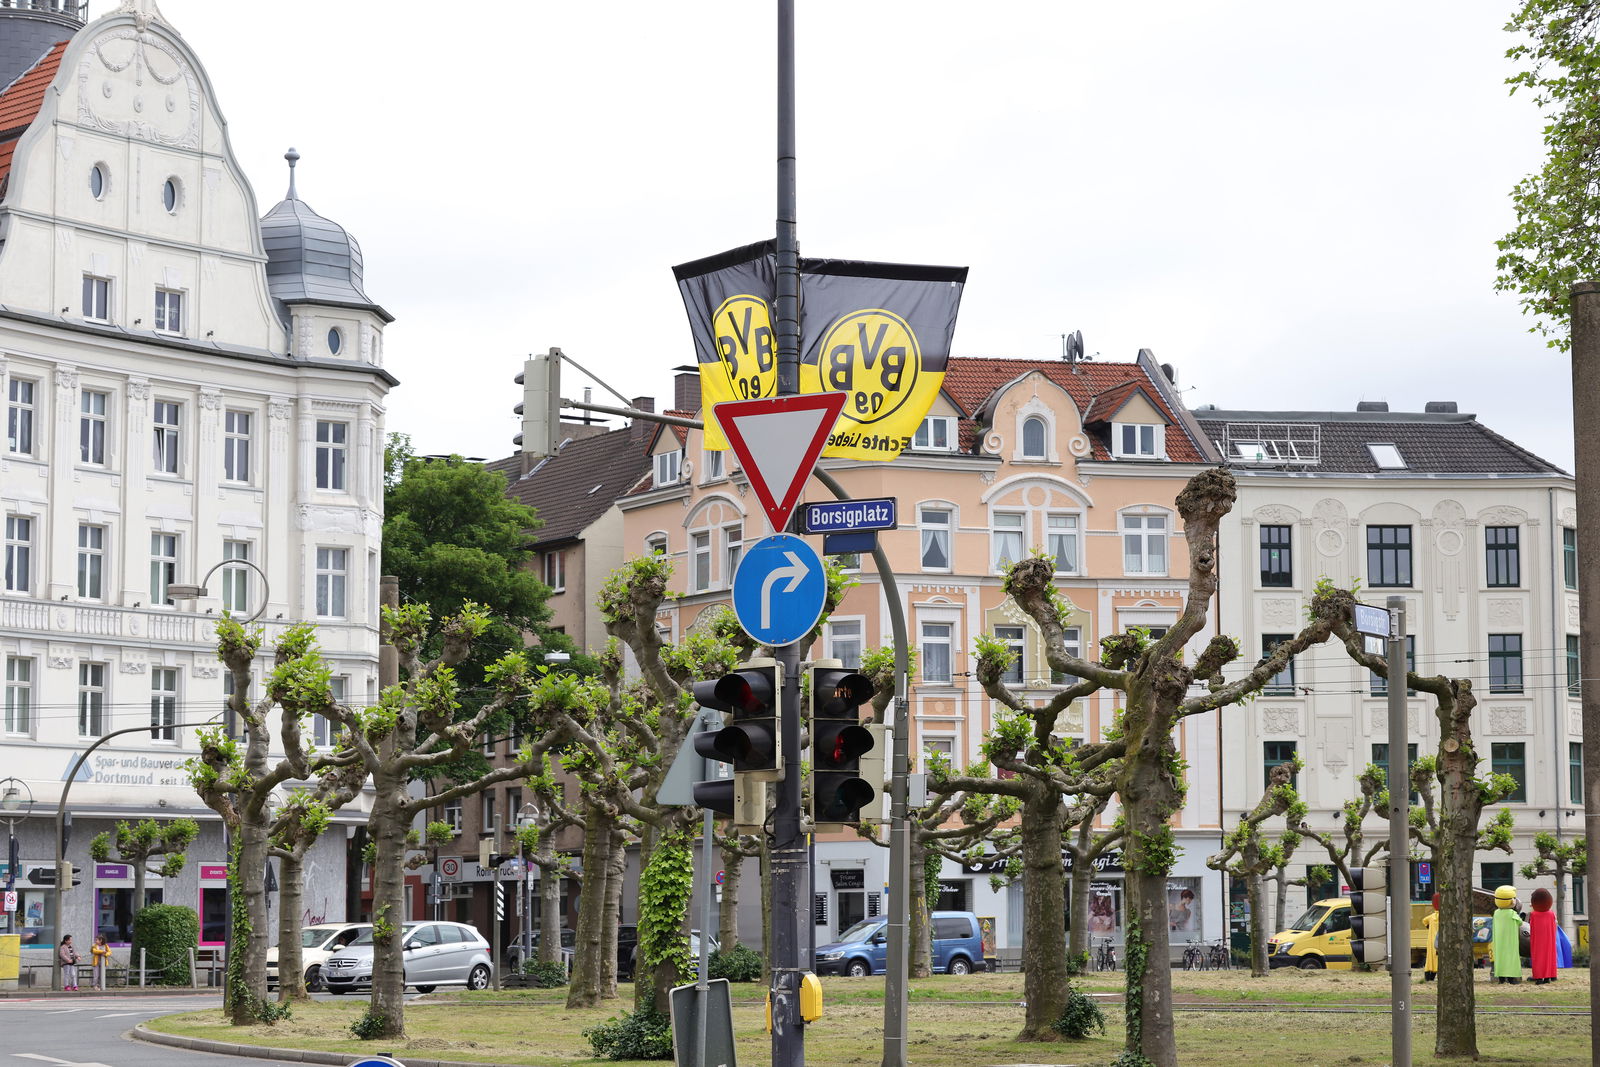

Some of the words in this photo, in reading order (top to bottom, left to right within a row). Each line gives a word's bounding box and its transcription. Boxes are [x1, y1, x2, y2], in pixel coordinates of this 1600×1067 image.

[719, 306, 774, 381] BVB
[739, 375, 762, 400] 09
[811, 504, 889, 527] Borsigplatz
[95, 755, 119, 770] Spar-
[121, 756, 139, 768] und
[95, 771, 153, 785] Dortmund
[160, 776, 177, 785] seit
[446, 863, 455, 872] 30
[1399, 1000, 1405, 1011] 3
